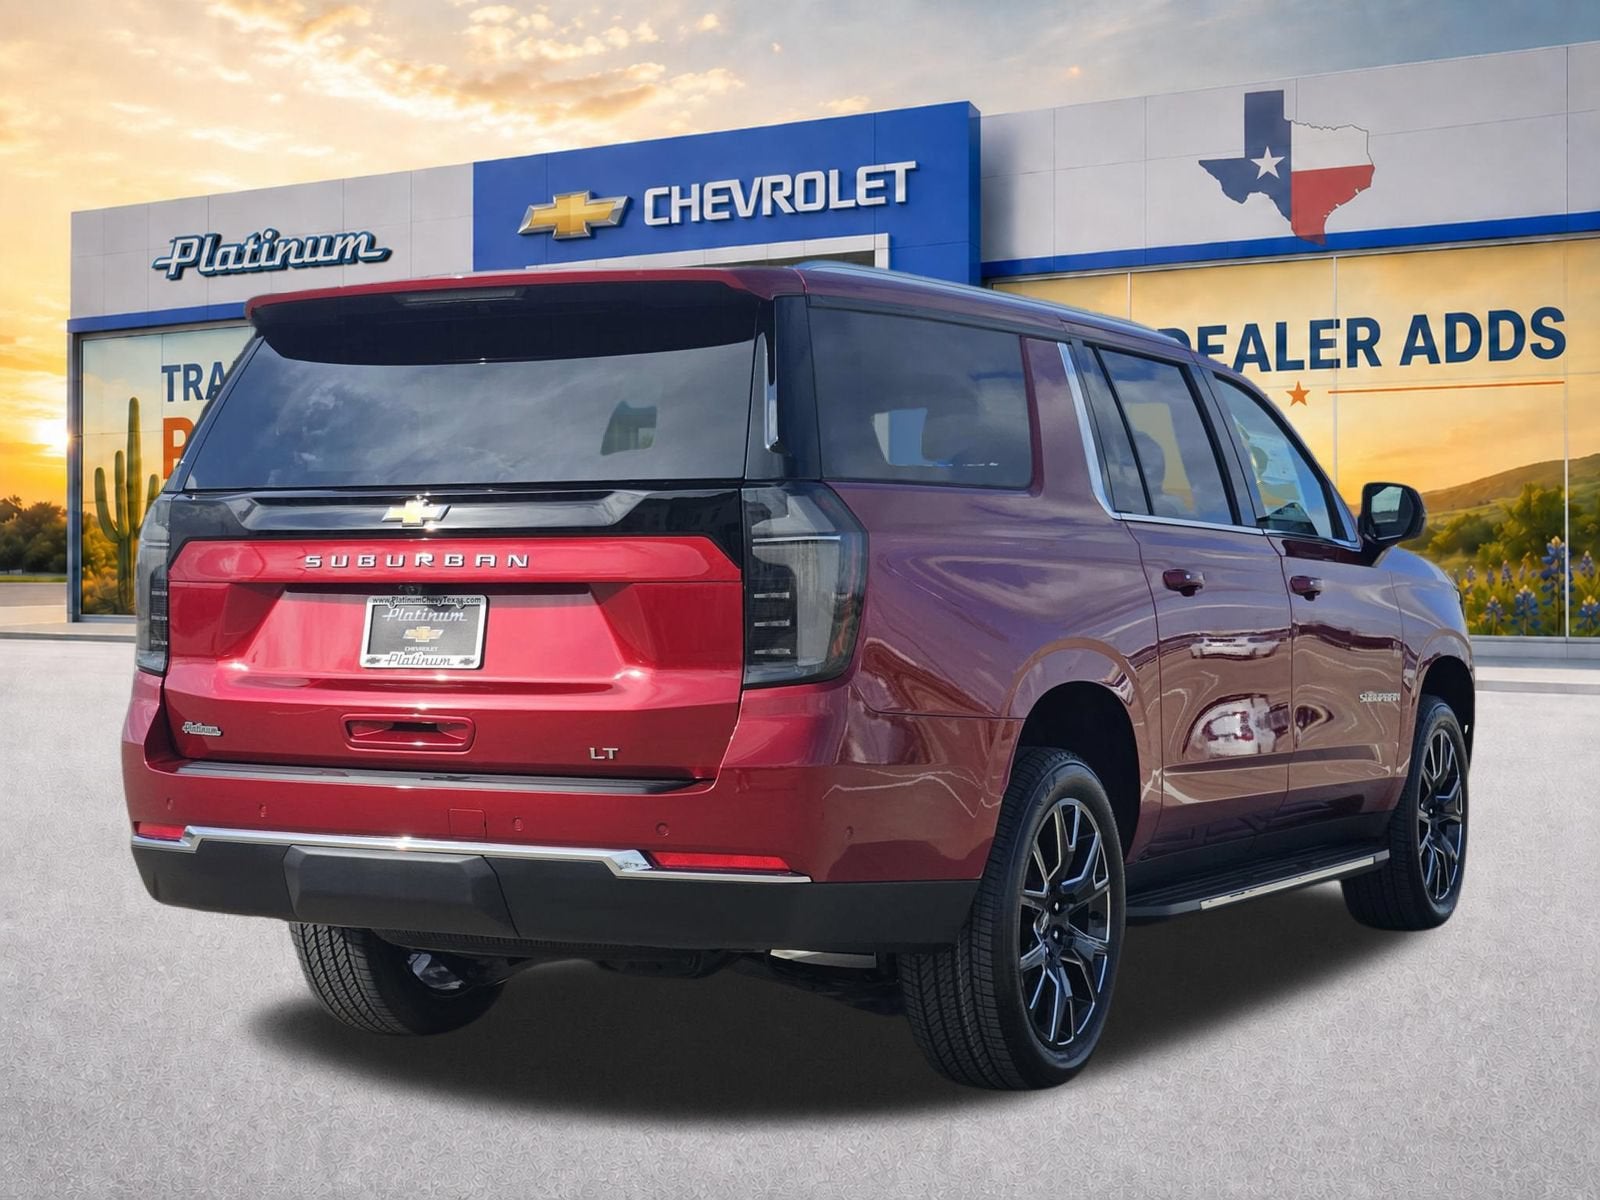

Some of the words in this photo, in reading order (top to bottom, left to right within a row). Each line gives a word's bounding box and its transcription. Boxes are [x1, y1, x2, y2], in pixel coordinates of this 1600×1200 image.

[643, 160, 917, 227] CHEVROLET
[153, 228, 391, 280] Platinum
[1400, 306, 1567, 366] ADDS
[305, 554, 530, 569] SUBURBAN
[382, 608, 468, 622] Platinum
[384, 653, 454, 666] Platinum
[182, 722, 221, 736] Platinum
[590, 747, 618, 760] LT
